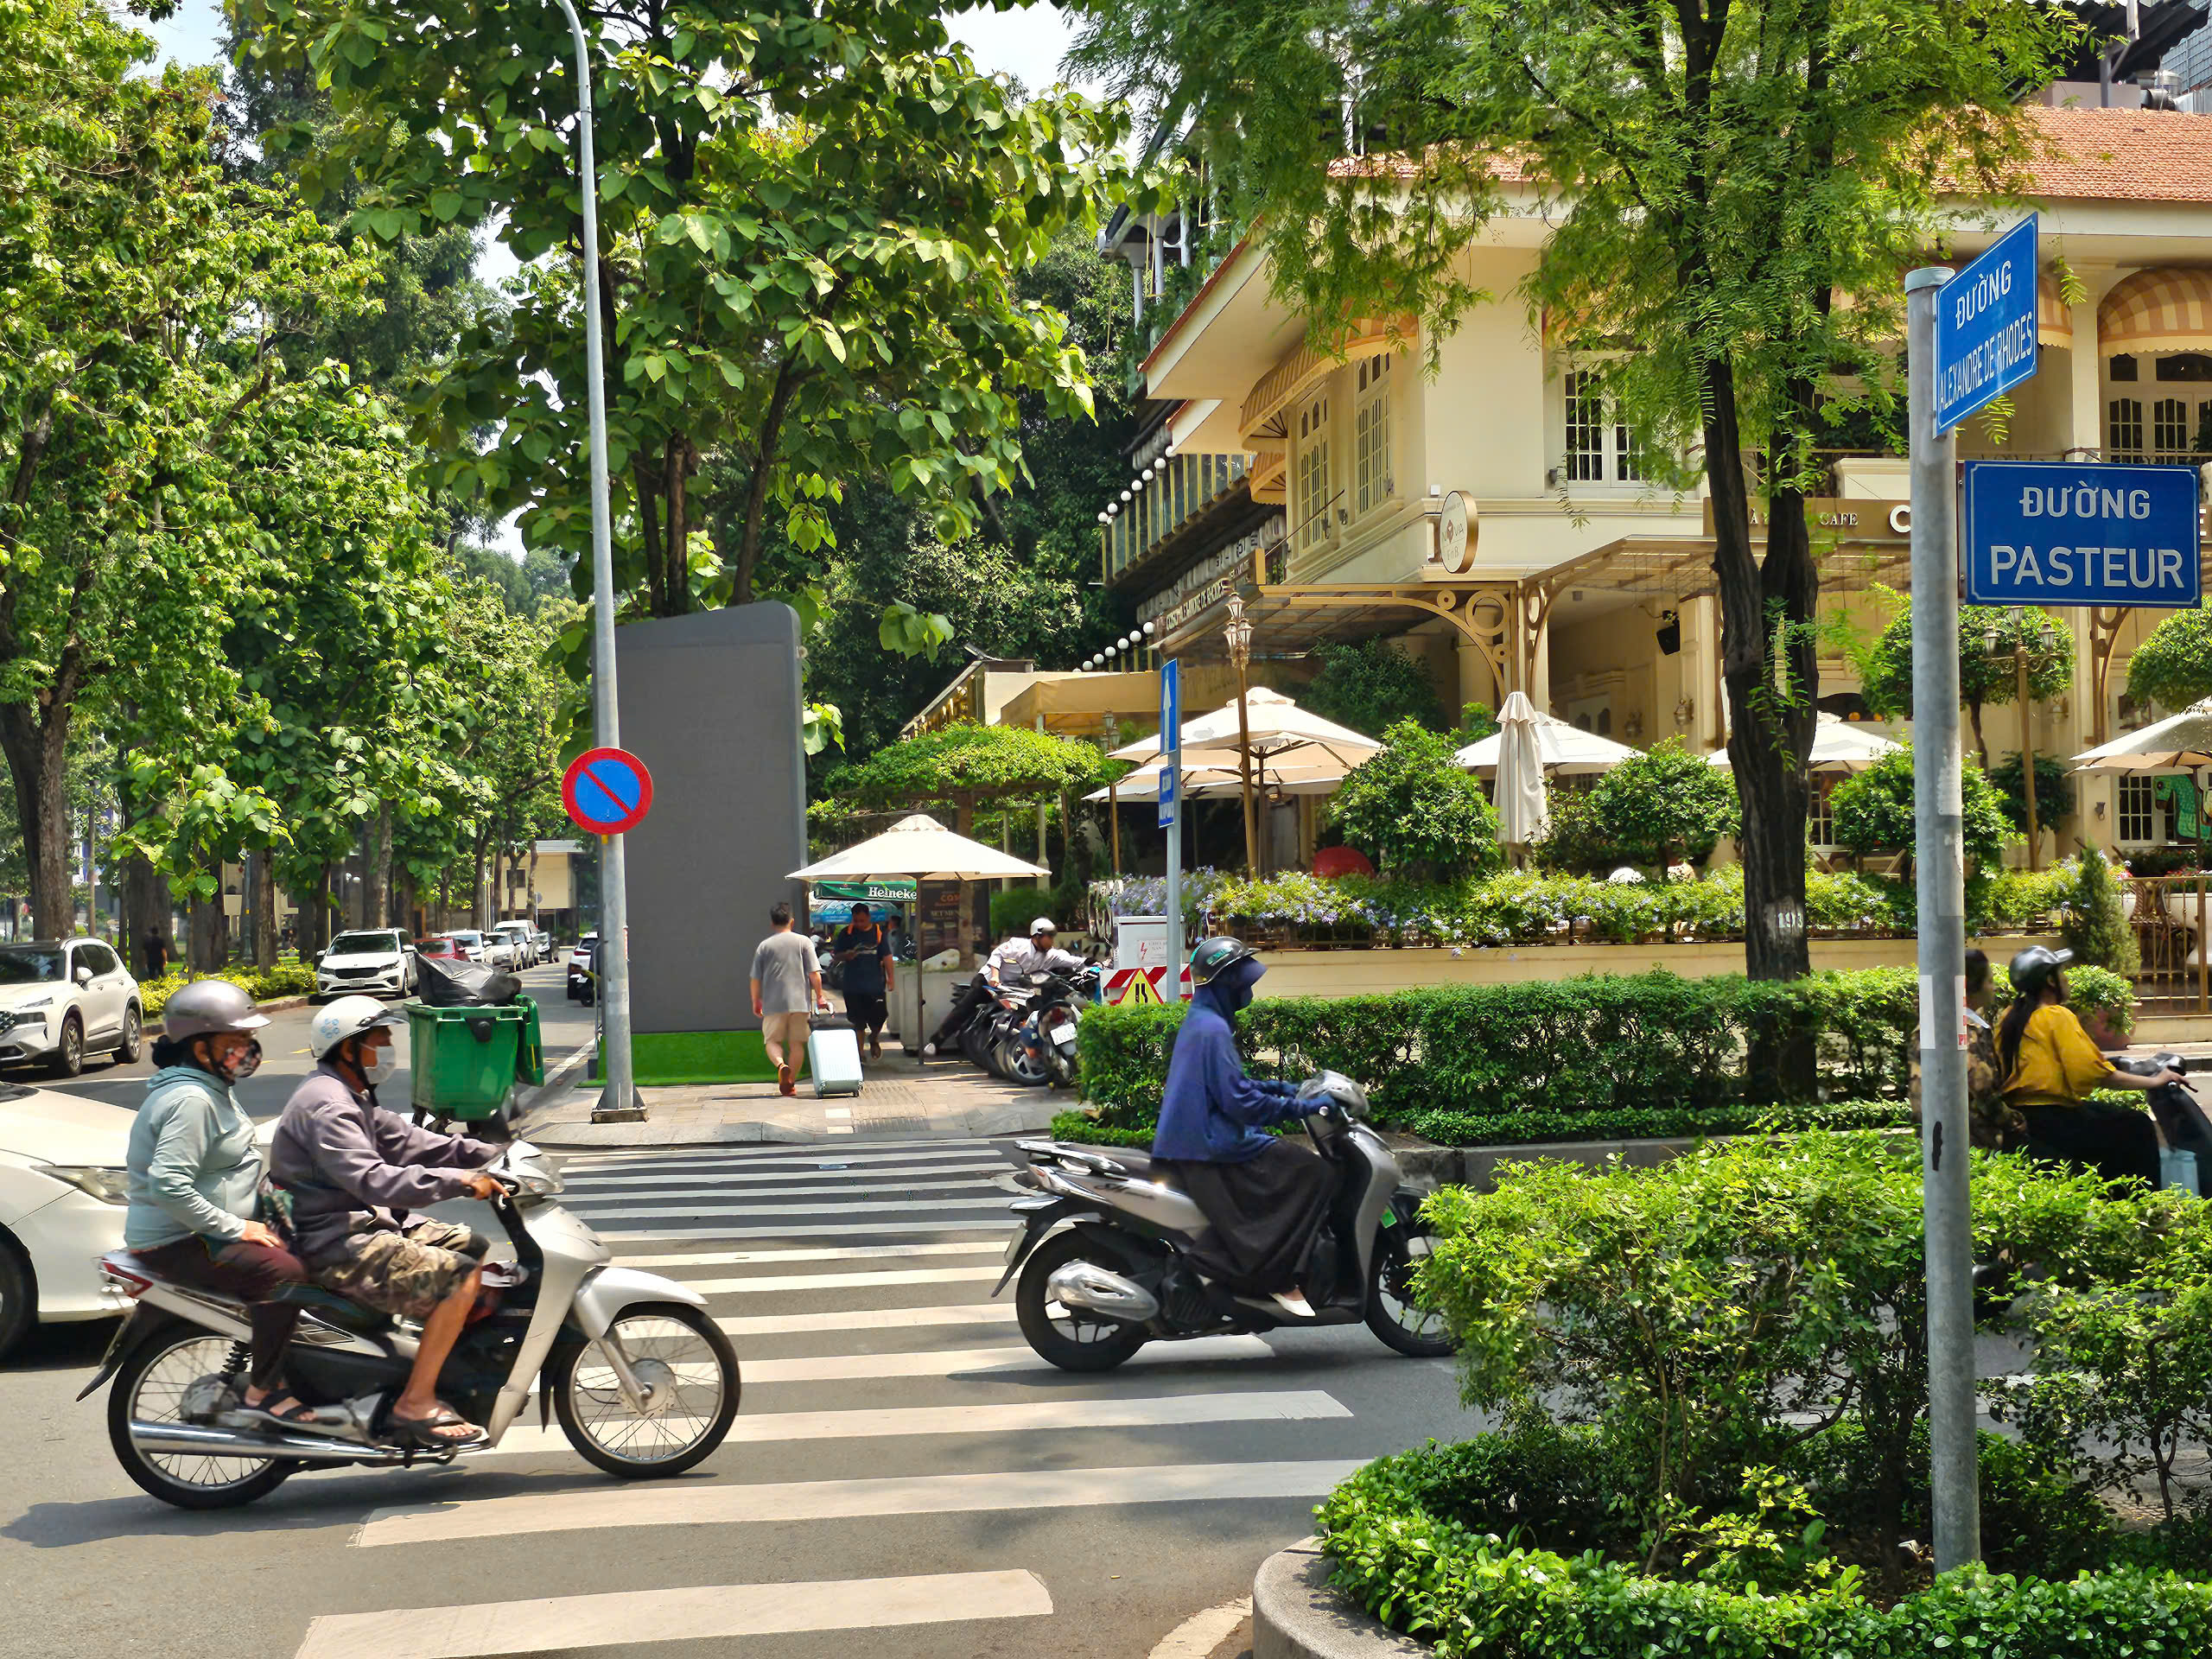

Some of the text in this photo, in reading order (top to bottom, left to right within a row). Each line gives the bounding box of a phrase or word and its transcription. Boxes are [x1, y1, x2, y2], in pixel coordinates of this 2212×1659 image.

[1955, 260, 2012, 330] ĐƯỜNG
[1939, 311, 2033, 413] ALEXANDRE DE RHODES
[2018, 480, 2151, 520] ĐƯỜNG
[1990, 545, 2185, 589] PASTEUR
[868, 886, 917, 899] Heineke
